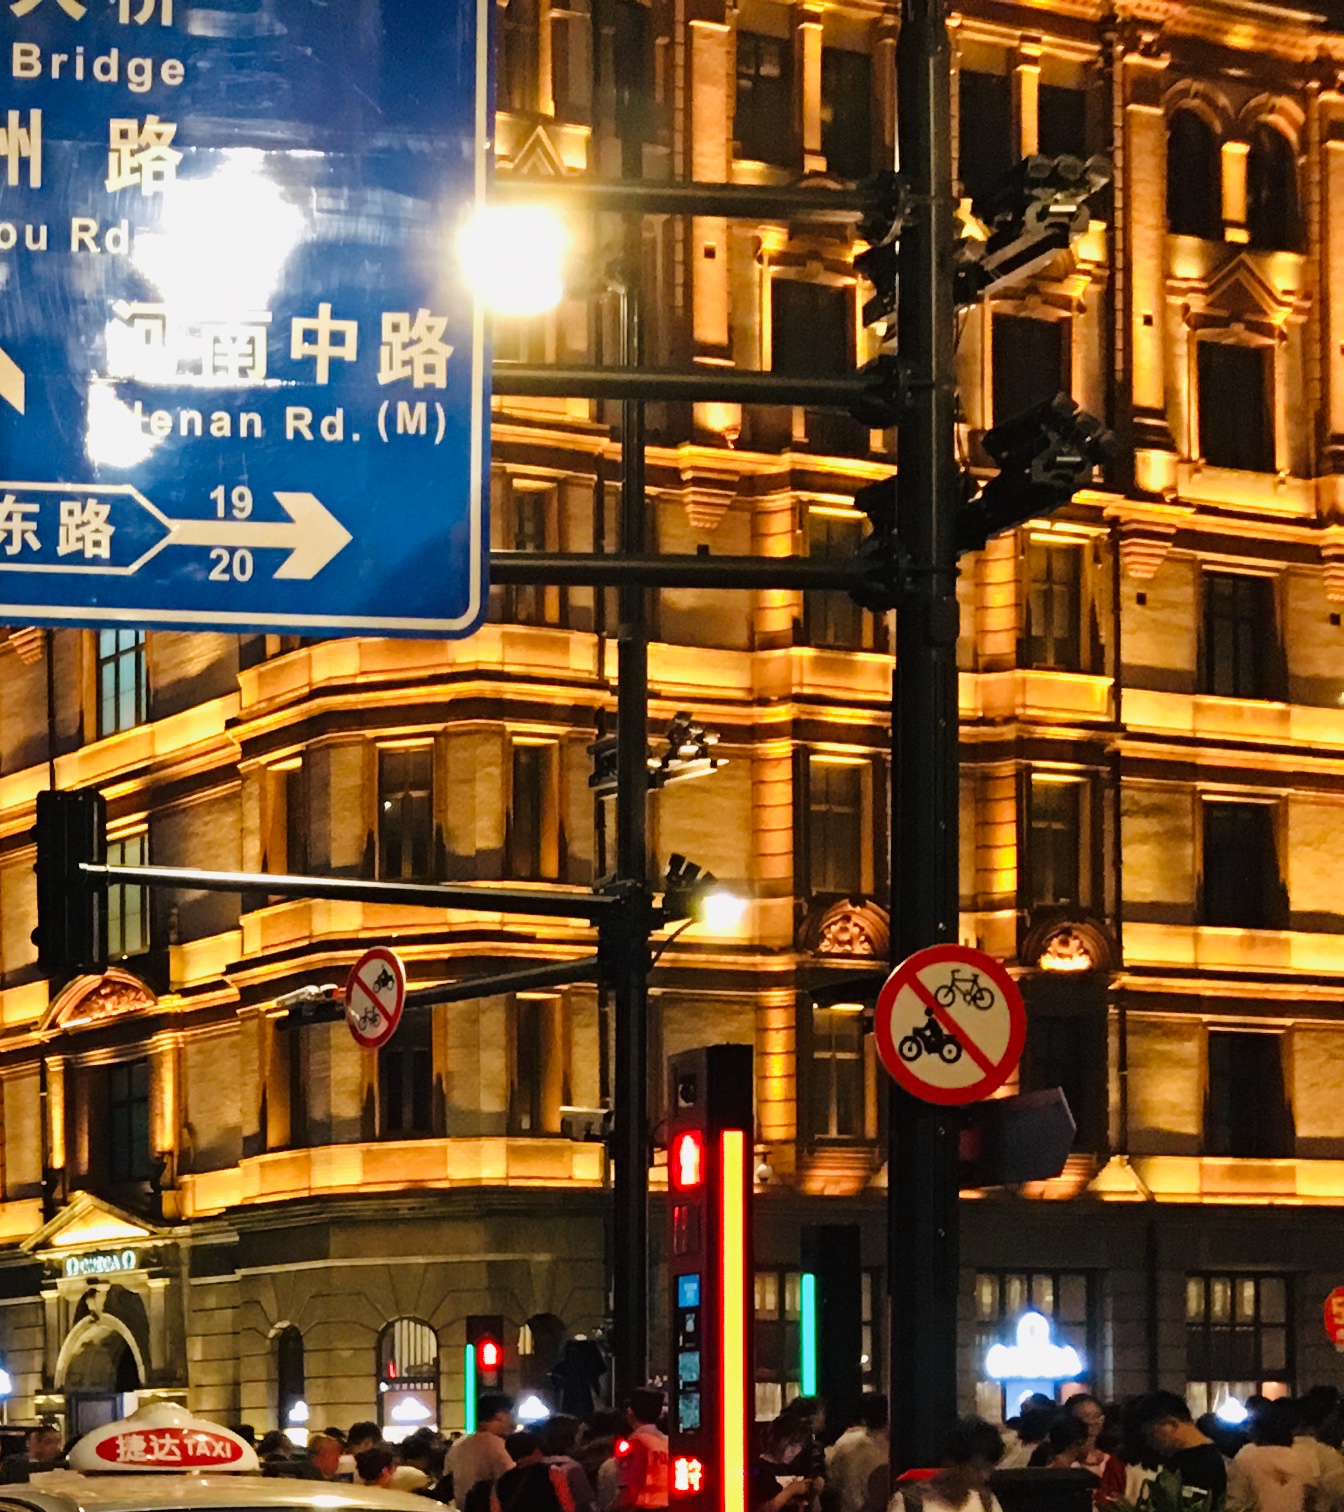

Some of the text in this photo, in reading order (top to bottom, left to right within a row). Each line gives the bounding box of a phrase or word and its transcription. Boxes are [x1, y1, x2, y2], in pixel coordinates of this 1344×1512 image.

[12, 42, 185, 93] Bridge
[285, 407, 360, 441] Rd.
[377, 400, 446, 444] (M)
[210, 485, 253, 519] 19
[209, 548, 254, 582] 20
[183, 1438, 232, 1459] TAXI
